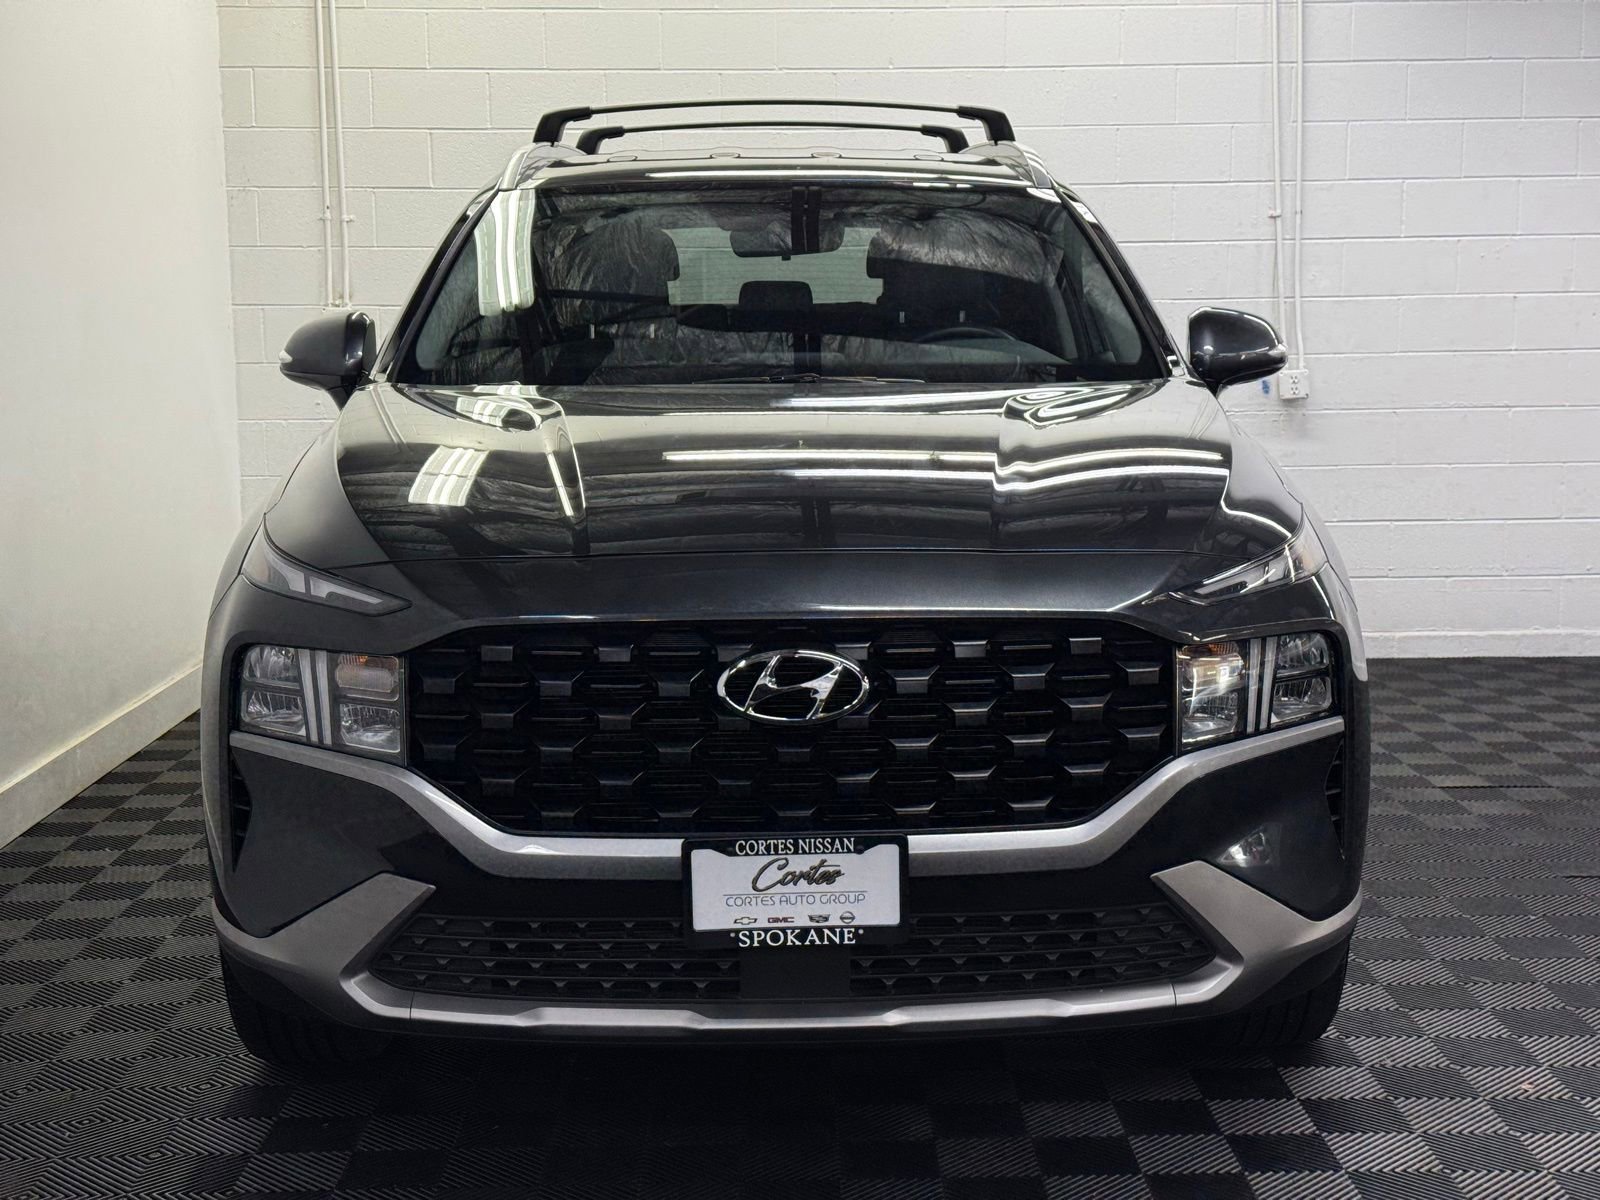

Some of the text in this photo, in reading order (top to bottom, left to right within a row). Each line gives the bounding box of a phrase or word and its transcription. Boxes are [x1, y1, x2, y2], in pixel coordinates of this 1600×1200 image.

[735, 837, 855, 856] CORTES NISSAN
[751, 857, 845, 893] Cortes
[725, 893, 866, 907] CORTES AUTO GROUP
[767, 916, 795, 924] GMC
[738, 928, 857, 947] SPOKANE
